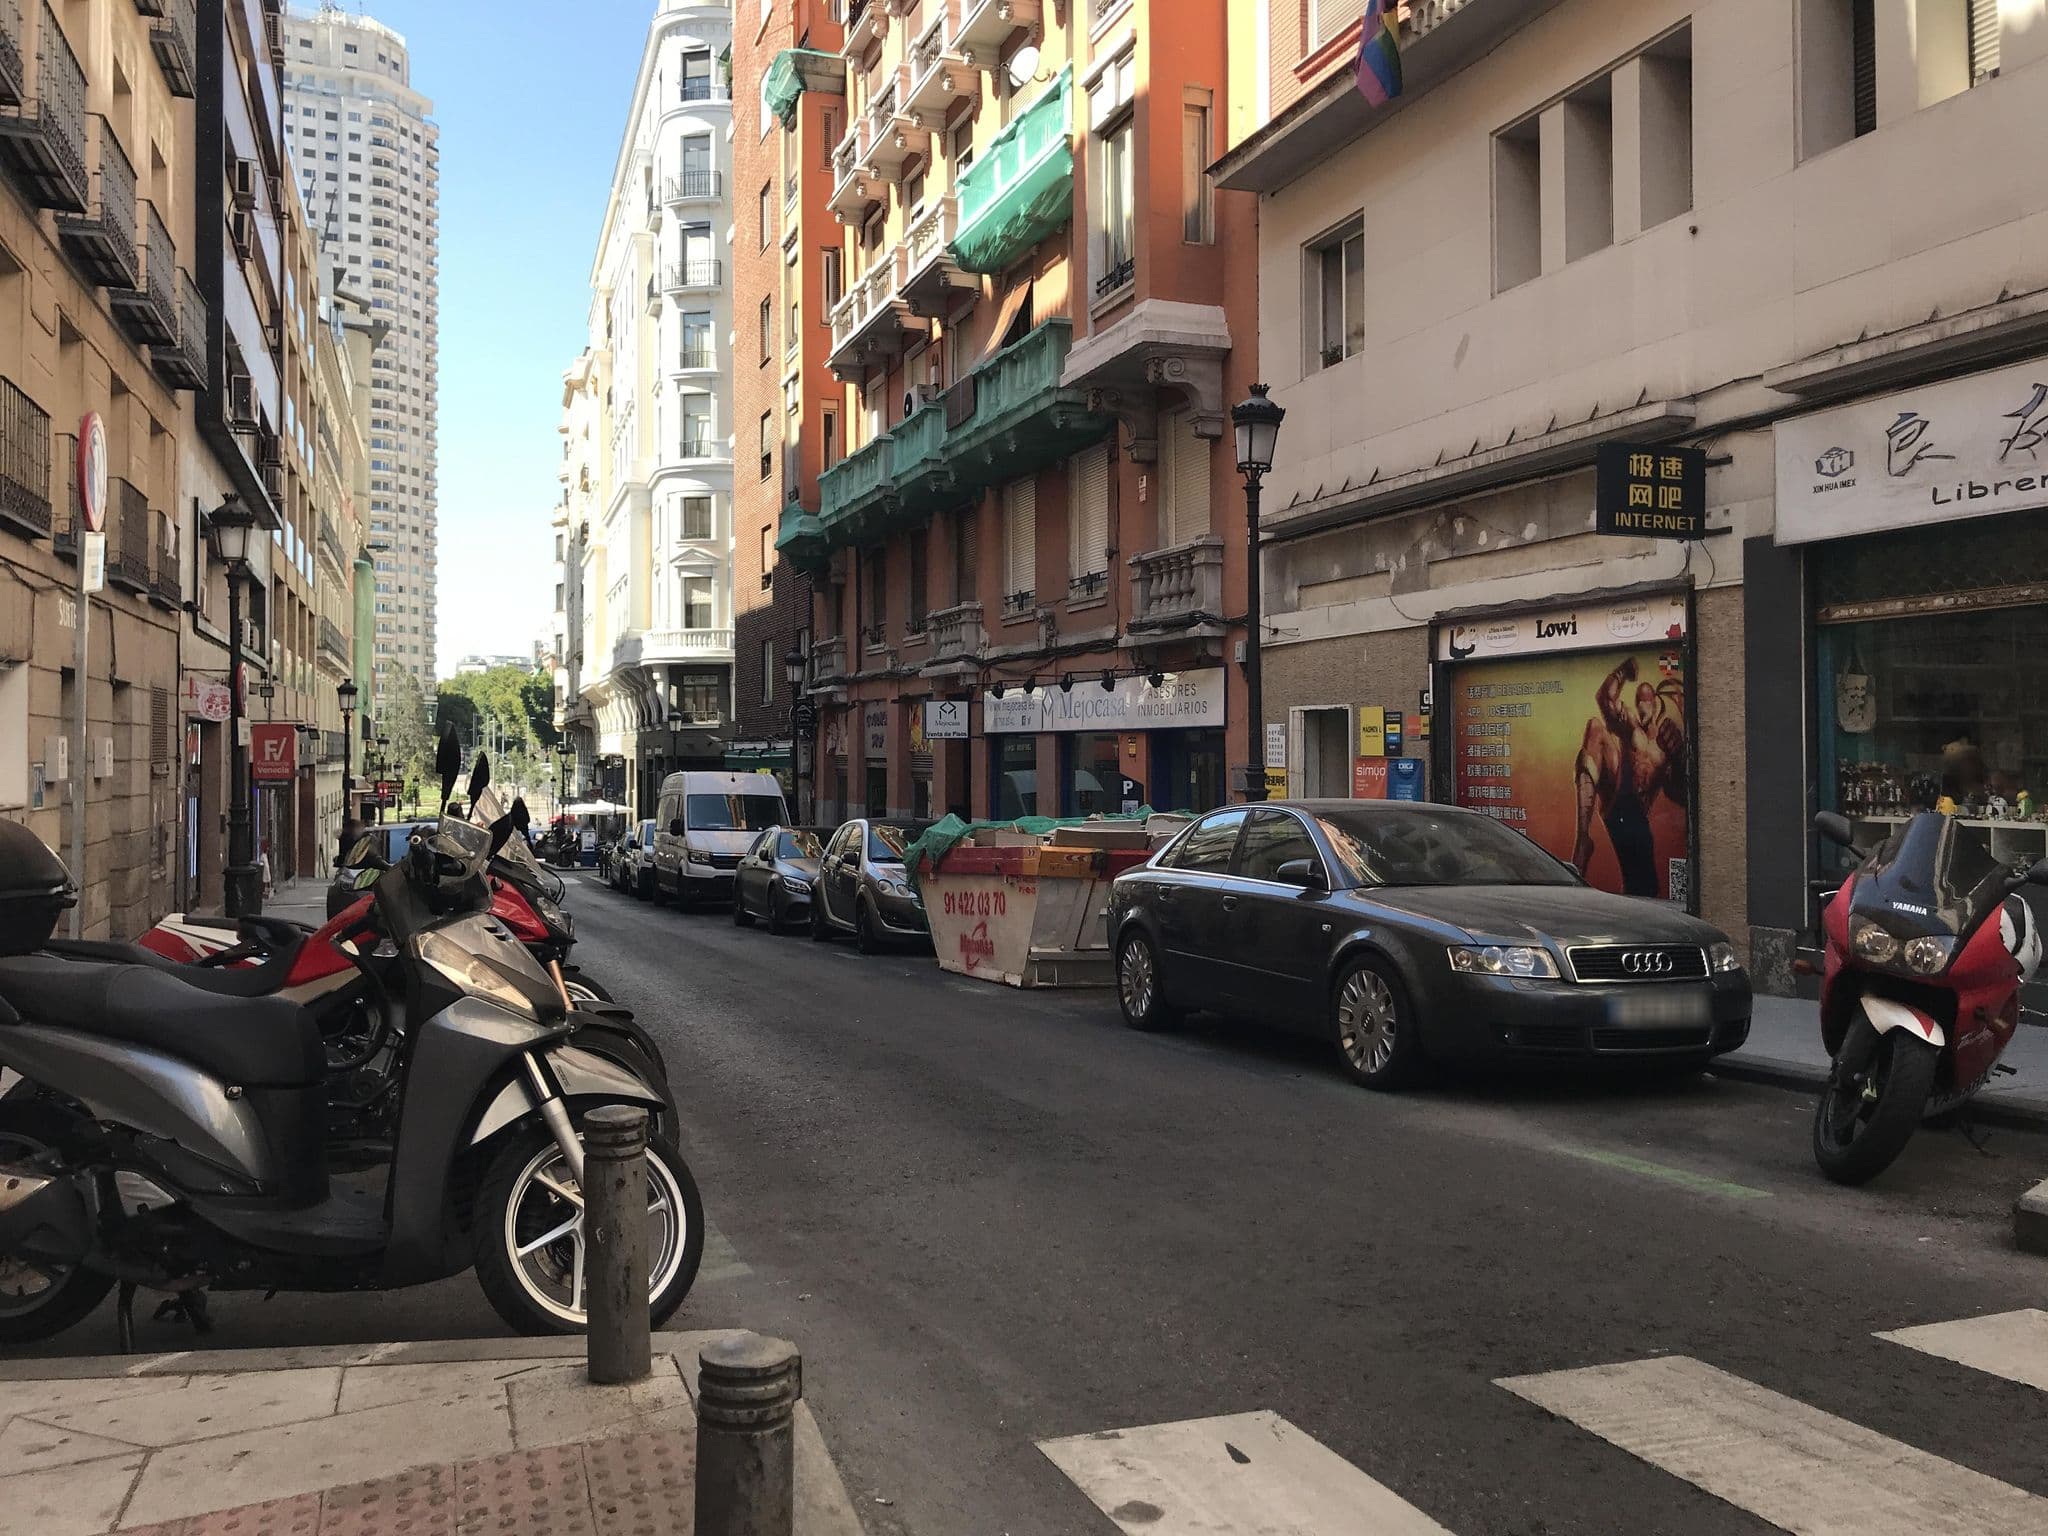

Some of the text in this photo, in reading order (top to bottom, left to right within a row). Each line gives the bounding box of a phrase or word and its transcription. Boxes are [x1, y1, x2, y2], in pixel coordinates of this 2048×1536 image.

[1629, 453, 1683, 480] 极速
[1812, 479, 1857, 494] XIN HUA IMEX
[1629, 484, 1682, 509] 网吧
[1615, 512, 1696, 531] INTERNET
[1535, 614, 1578, 639] Lowi
[1147, 683, 1197, 699] ASESORES
[1058, 691, 1127, 726] Mejocasa
[1137, 700, 1208, 717] INMOBILIARIOS
[1356, 764, 1386, 780] simyo
[1123, 781, 1134, 795] P
[944, 890, 1006, 916] 91 422 03 70
[1892, 901, 1928, 916] YAMAHA
